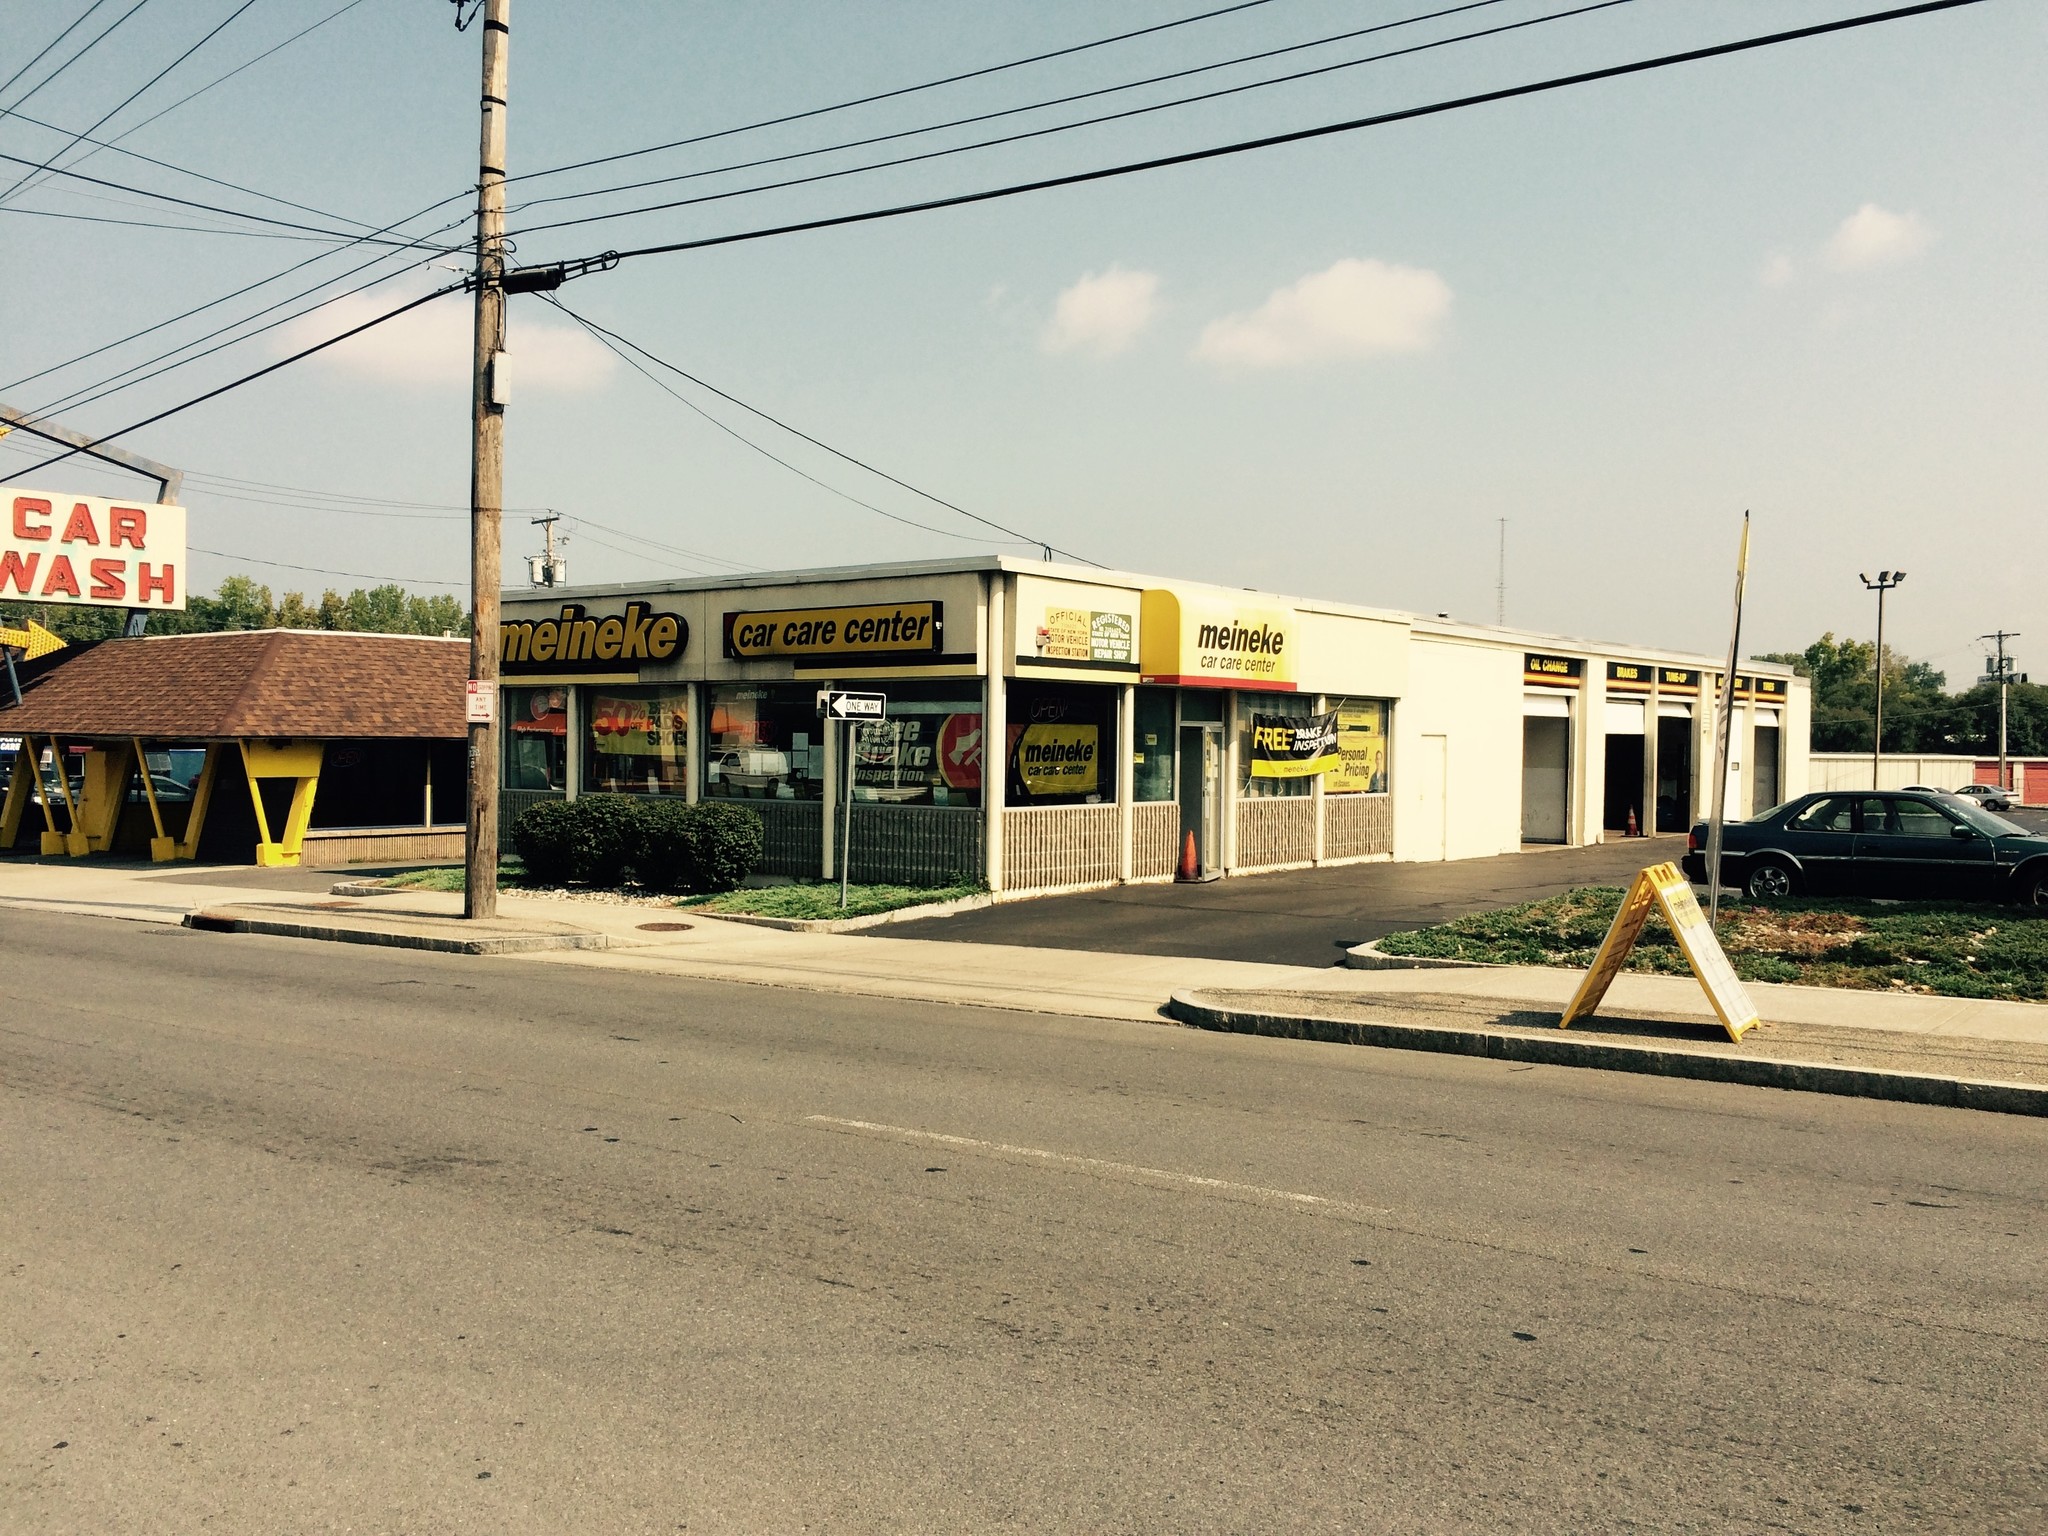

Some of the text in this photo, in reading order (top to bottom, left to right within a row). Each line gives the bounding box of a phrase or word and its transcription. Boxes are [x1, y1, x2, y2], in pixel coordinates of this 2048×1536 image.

[13, 497, 147, 548] CAR
[0, 550, 174, 602] WASH
[1050, 611, 1087, 628] OFFICIAL
[1092, 614, 1130, 633] REGISTERED
[500, 605, 677, 661] meineke
[739, 610, 930, 647] car care center
[1067, 635, 1088, 646] VEHICLE
[1110, 639, 1131, 650] VEHICLE
[1198, 620, 1284, 655] meineke
[1046, 645, 1088, 657] INSPECTION STATION
[1113, 650, 1128, 660] SHOP
[1201, 655, 1275, 672] car care center
[1530, 658, 1568, 673] OIL CHANGE
[1616, 666, 1638, 679] BRAKES
[1666, 671, 1687, 683] TUNE-UP
[647, 700, 687, 714] BRAK
[846, 702, 880, 712] ONE WAY
[630, 721, 643, 730] OFF
[647, 715, 683, 730] PADS
[1254, 726, 1322, 751] FREE BRAKE
[1025, 739, 1094, 762] meineke
[1338, 746, 1368, 760] Personal
[1028, 764, 1086, 776] car care center
[1344, 762, 1370, 779] Pricing
